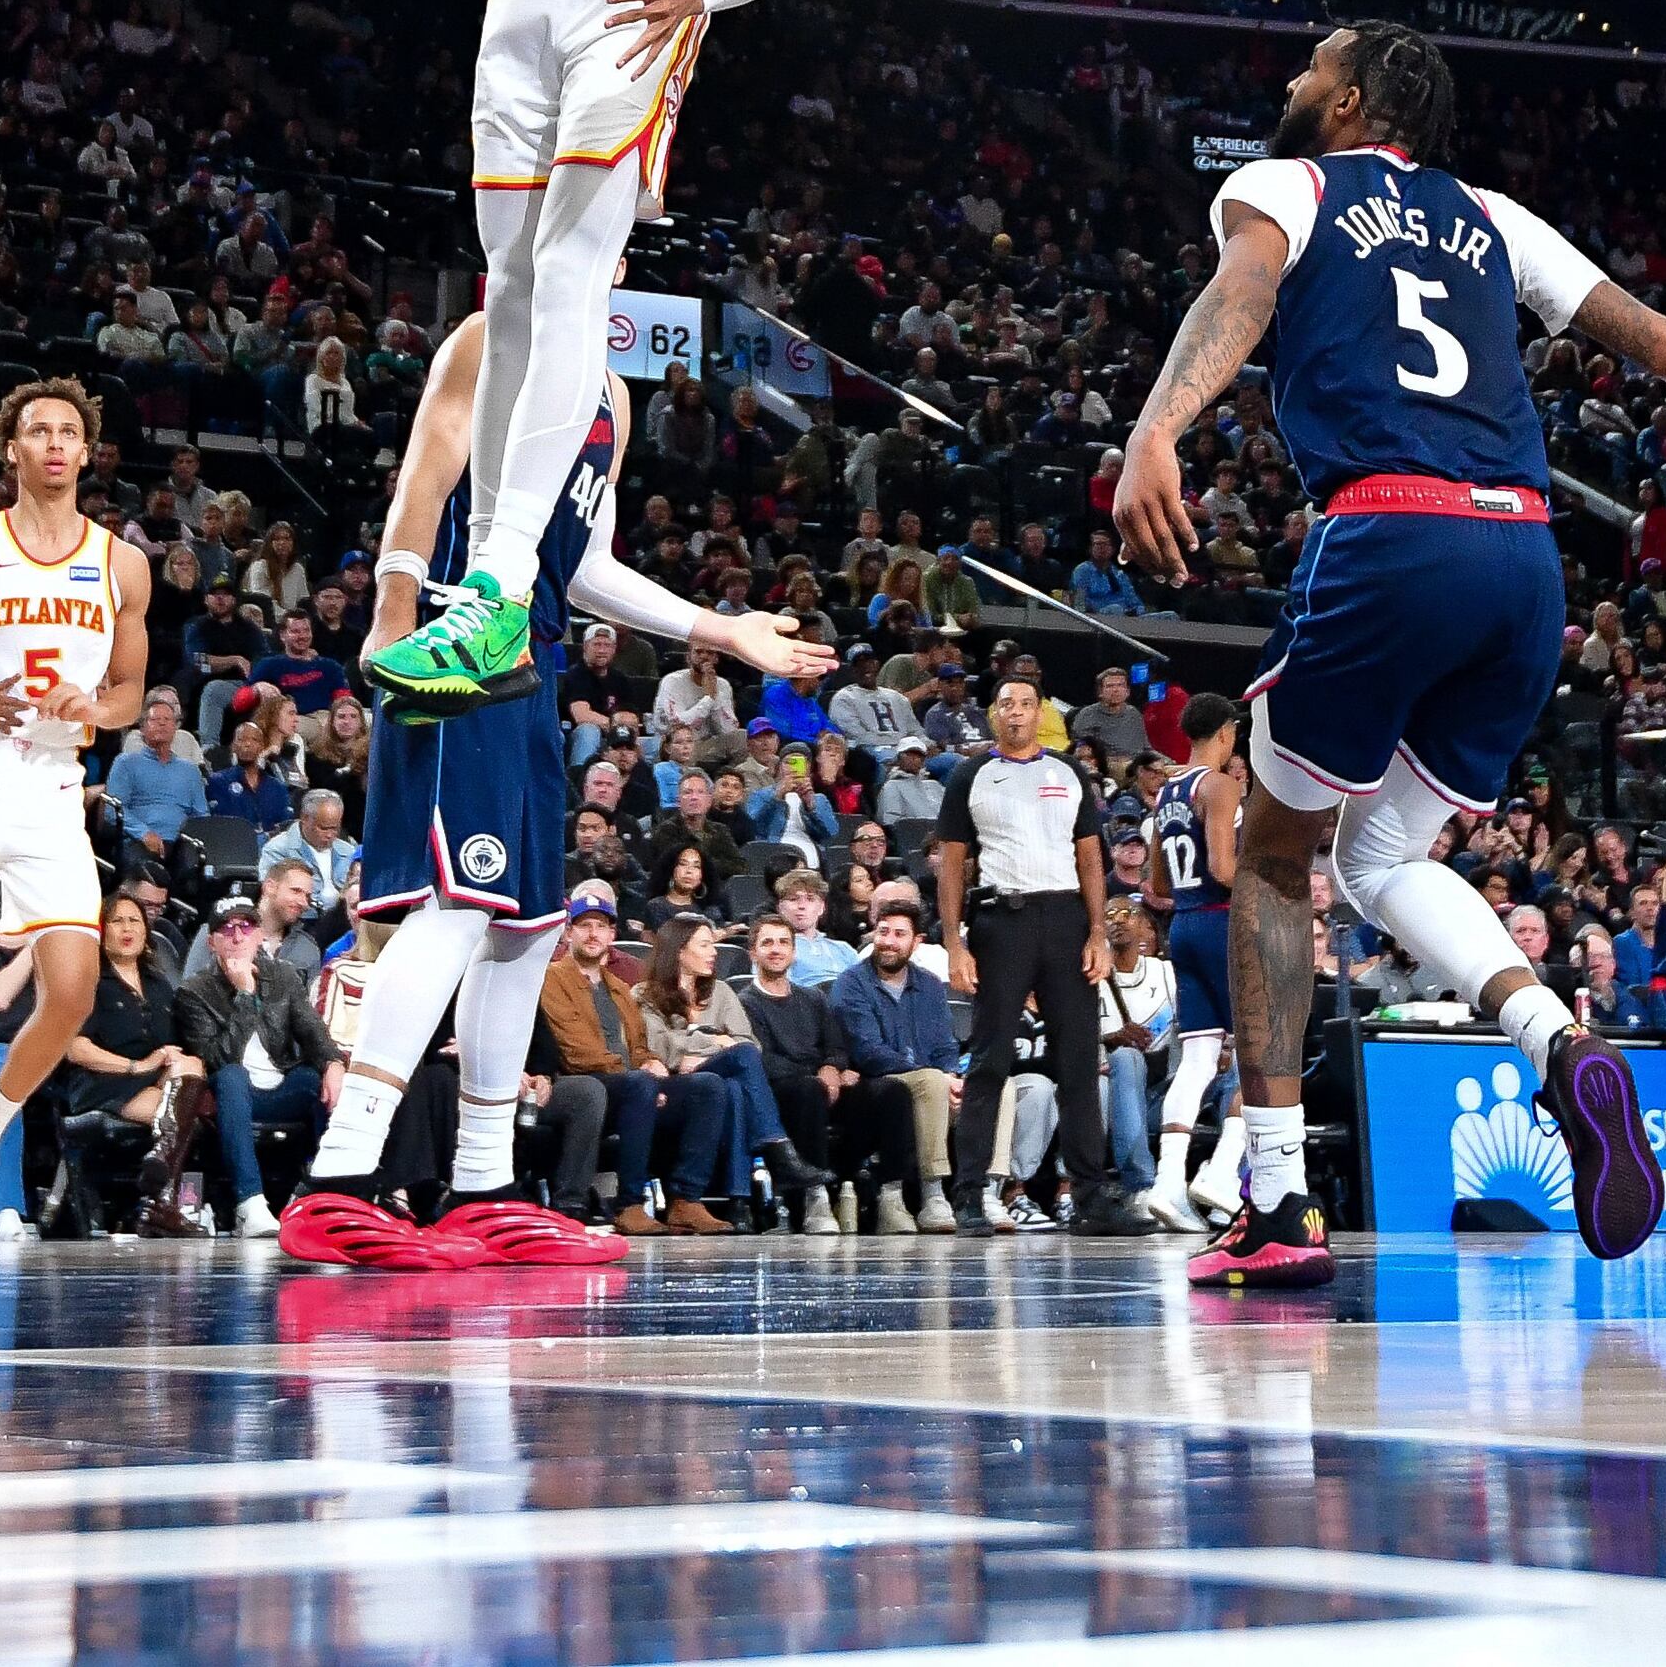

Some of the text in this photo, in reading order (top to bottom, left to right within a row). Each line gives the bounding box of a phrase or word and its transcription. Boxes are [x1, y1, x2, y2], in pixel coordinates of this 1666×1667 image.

[1193, 135, 1268, 154] EXPERIENCE
[1211, 159, 1244, 171] LEX
[1334, 196, 1492, 276] JONES JR.
[650, 324, 692, 358] 62
[1390, 266, 1469, 399] 5
[24, 647, 62, 700] 5
[868, 701, 899, 732] H
[1161, 834, 1203, 889] 12
